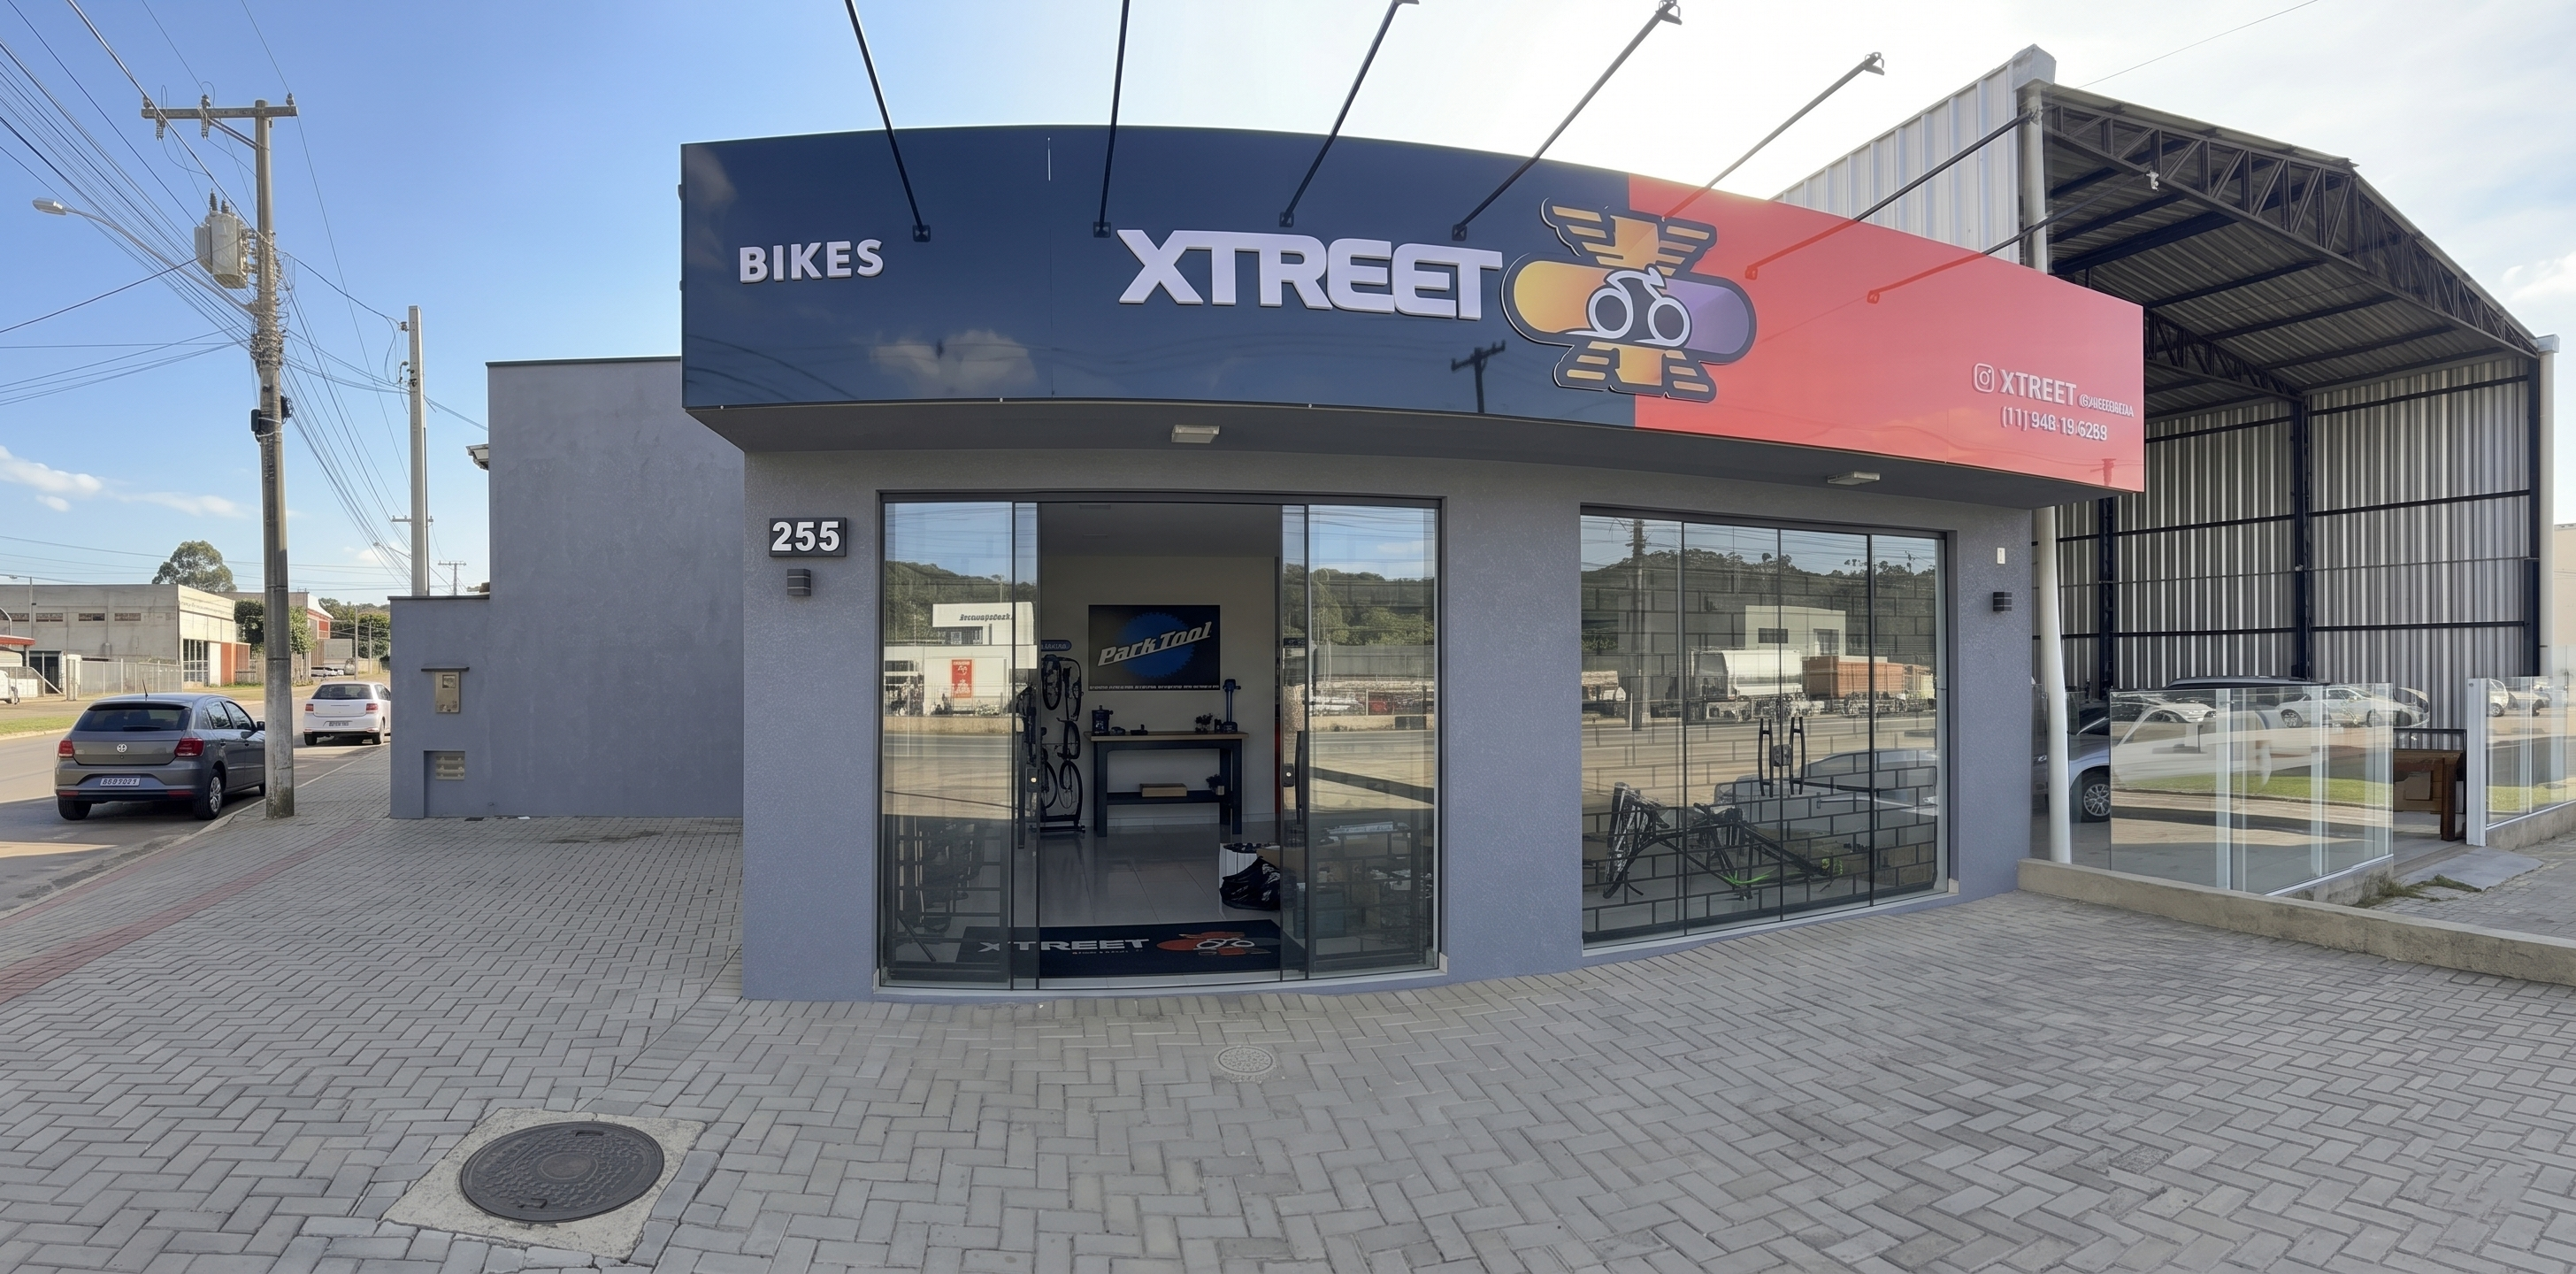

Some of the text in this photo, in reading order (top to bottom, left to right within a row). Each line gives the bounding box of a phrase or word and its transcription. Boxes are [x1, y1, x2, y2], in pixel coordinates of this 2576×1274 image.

[740, 239, 884, 284] BIKES
[1116, 229, 1504, 321] XTREET
[1997, 369, 2077, 406] XTREET
[771, 520, 840, 552] 255
[1098, 621, 1212, 667] Park Tool
[978, 938, 1150, 953] XTREET
